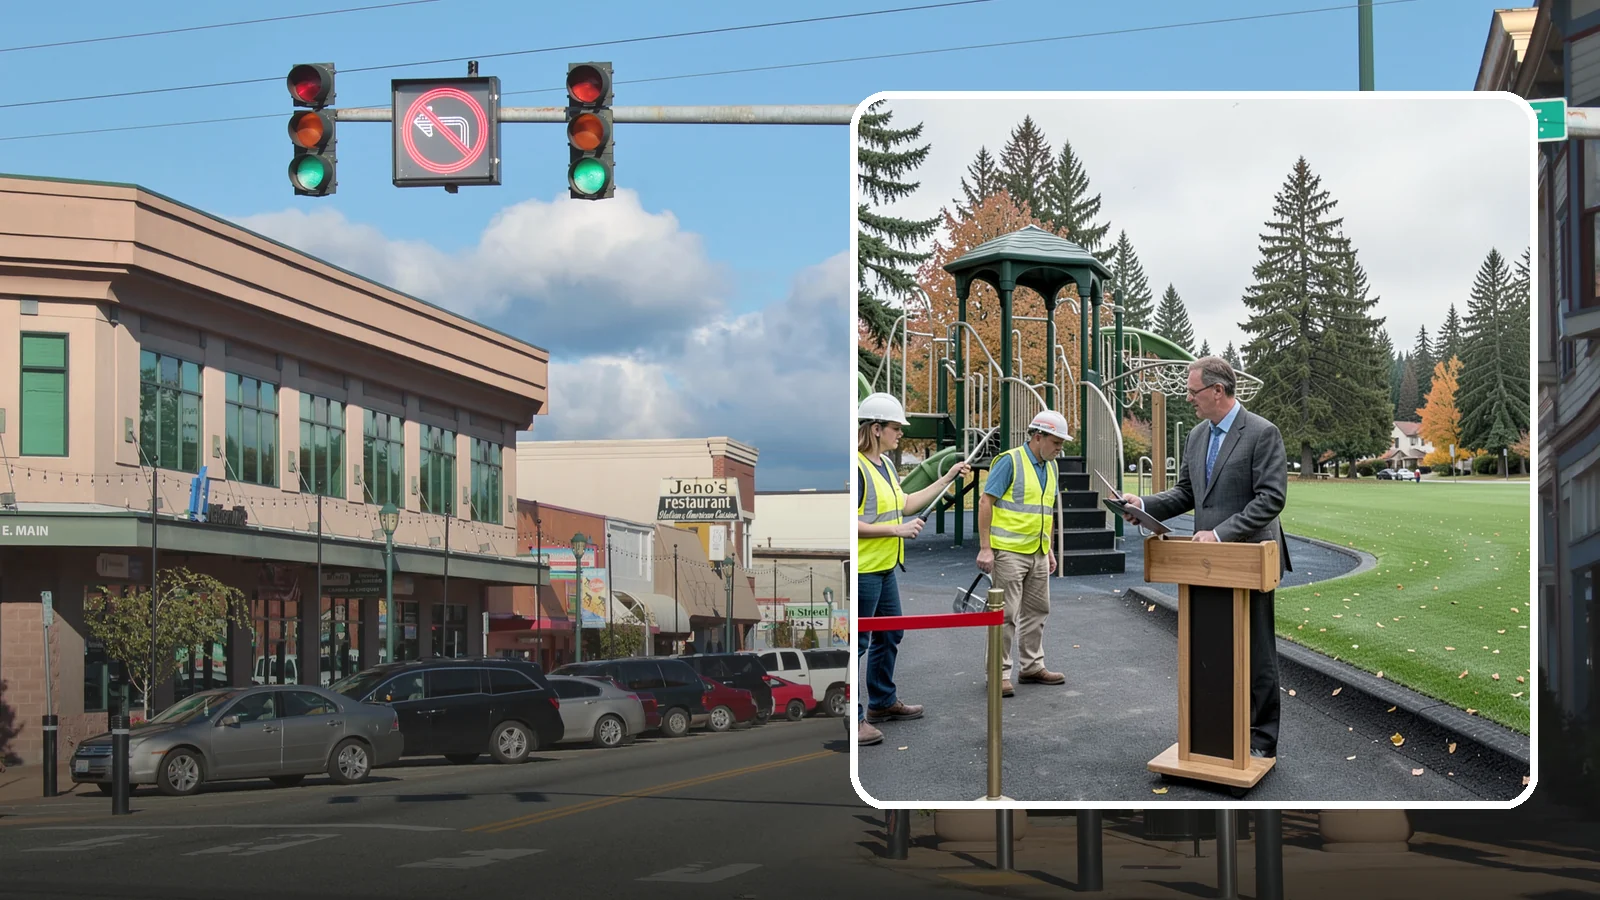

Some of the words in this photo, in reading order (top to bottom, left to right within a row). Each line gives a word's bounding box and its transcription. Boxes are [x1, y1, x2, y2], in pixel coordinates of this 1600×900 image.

[669, 480, 727, 494] Jeno's
[665, 496, 731, 509] restaurant
[658, 510, 682, 519] Italian
[686, 509, 714, 519] American
[715, 509, 737, 519] Cuisine
[2, 525, 13, 536] E.
[15, 525, 49, 536] MAIN
[797, 607, 828, 617] Street
